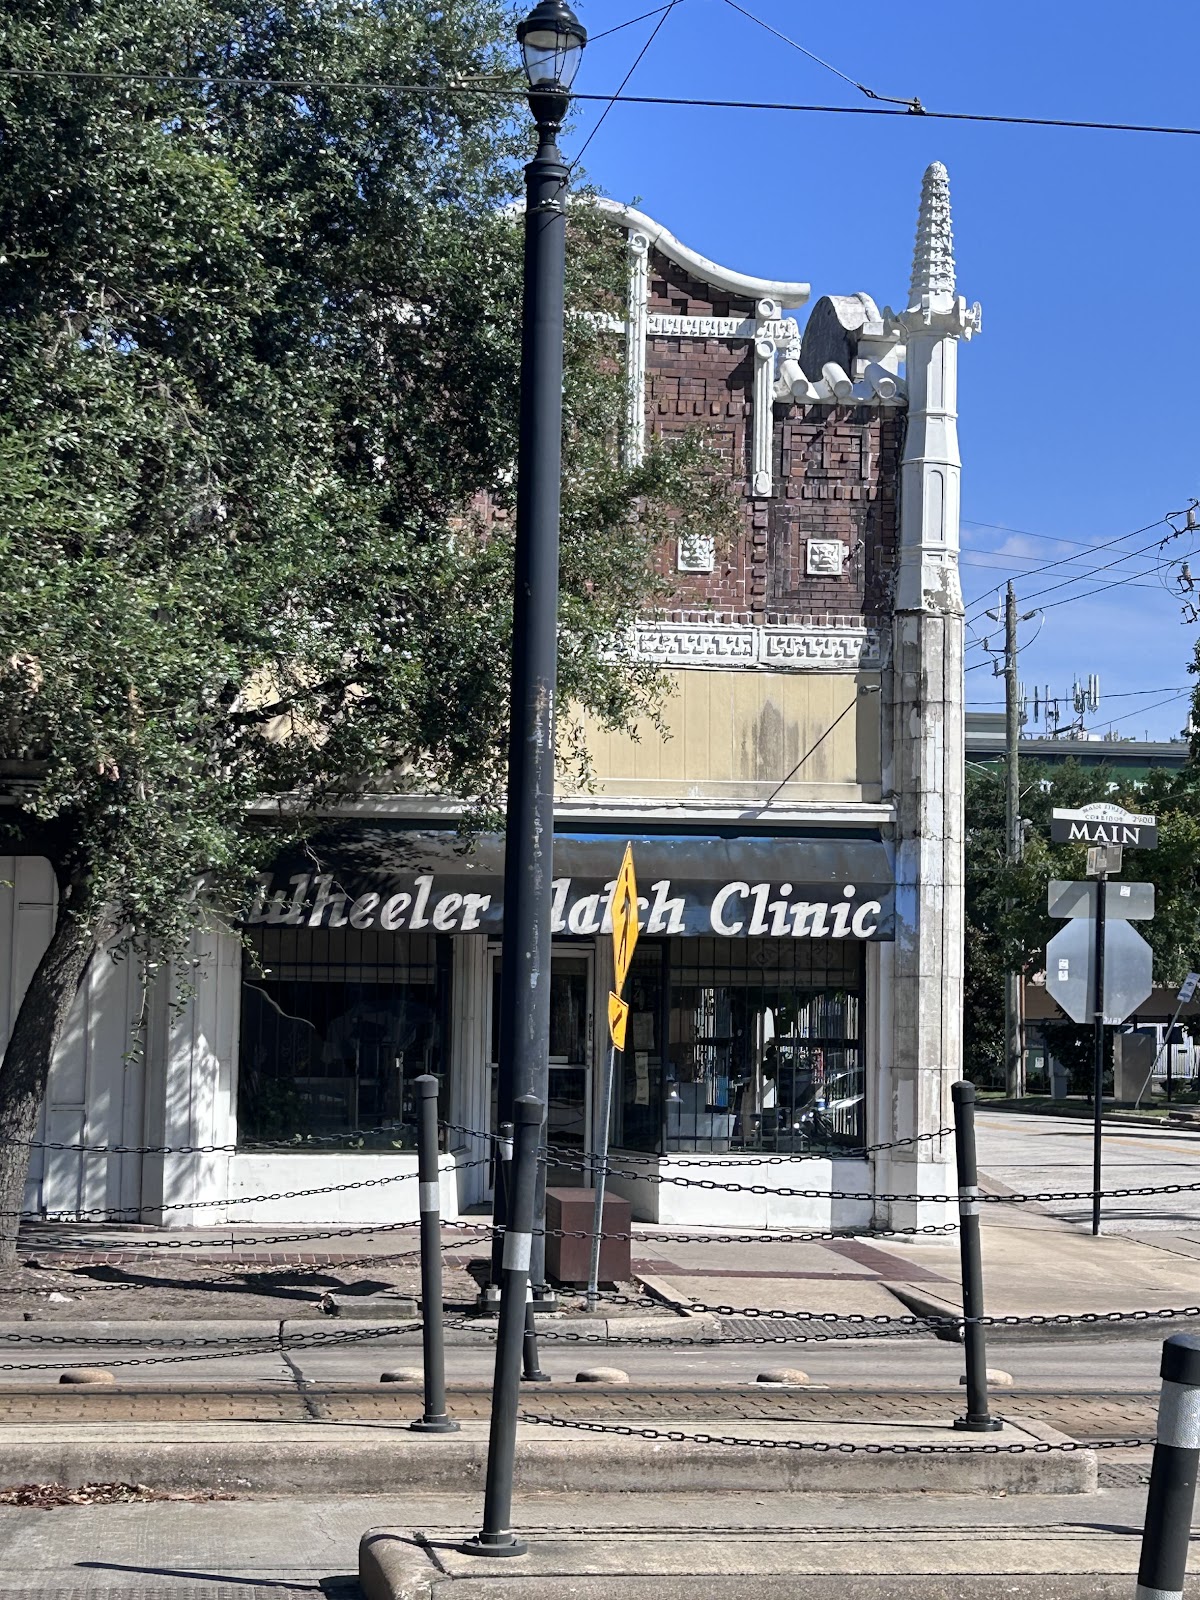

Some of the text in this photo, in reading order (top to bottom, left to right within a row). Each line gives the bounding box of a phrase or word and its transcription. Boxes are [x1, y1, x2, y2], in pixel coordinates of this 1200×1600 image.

[1132, 815, 1153, 824] 2900
[1068, 822, 1140, 844] MAIN
[248, 872, 492, 931] Wheeler
[711, 881, 882, 940] Clinic
